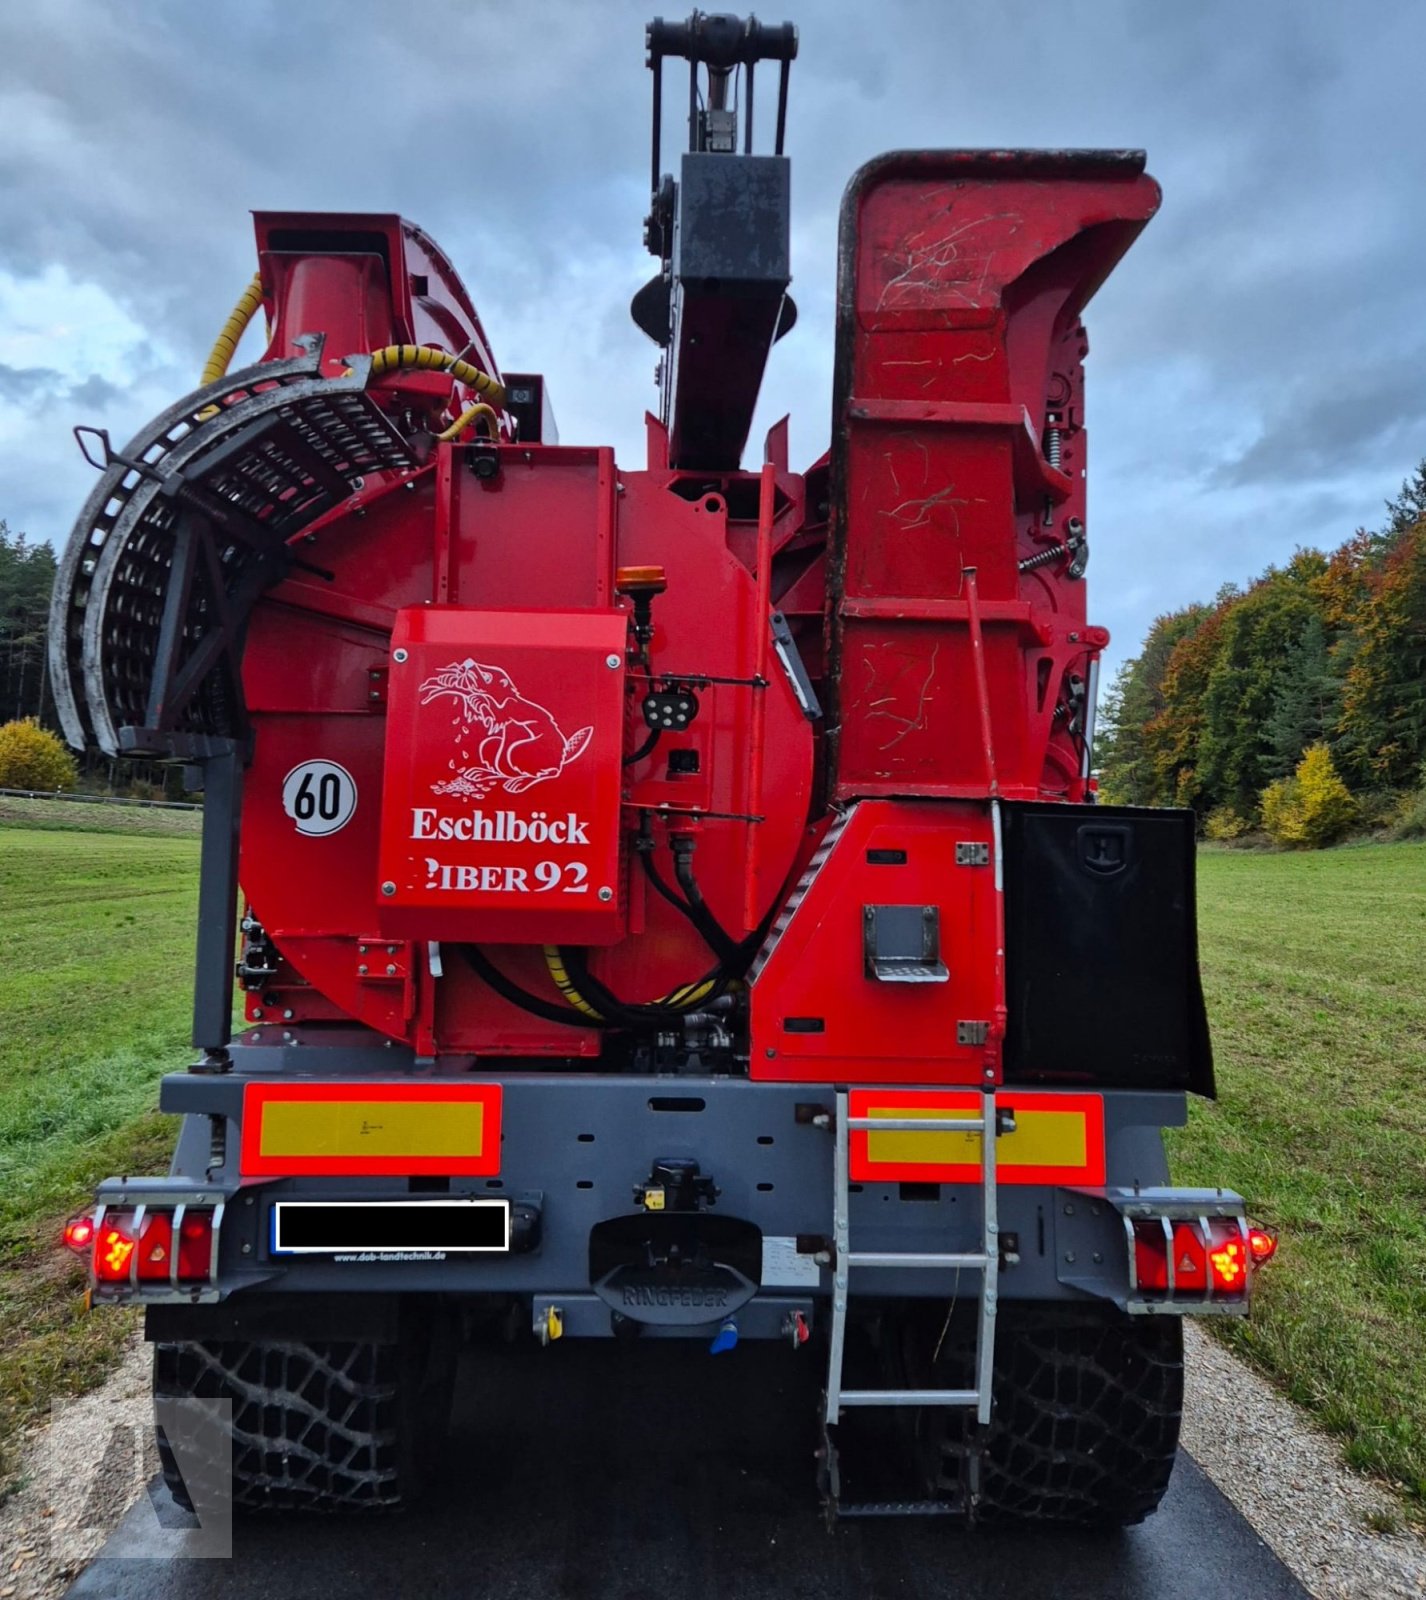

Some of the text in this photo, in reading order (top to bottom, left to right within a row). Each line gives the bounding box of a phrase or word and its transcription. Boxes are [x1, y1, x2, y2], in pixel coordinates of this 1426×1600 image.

[294, 773, 341, 820] 60
[409, 808, 590, 845] Eschlböck
[534, 861, 589, 893] 92
